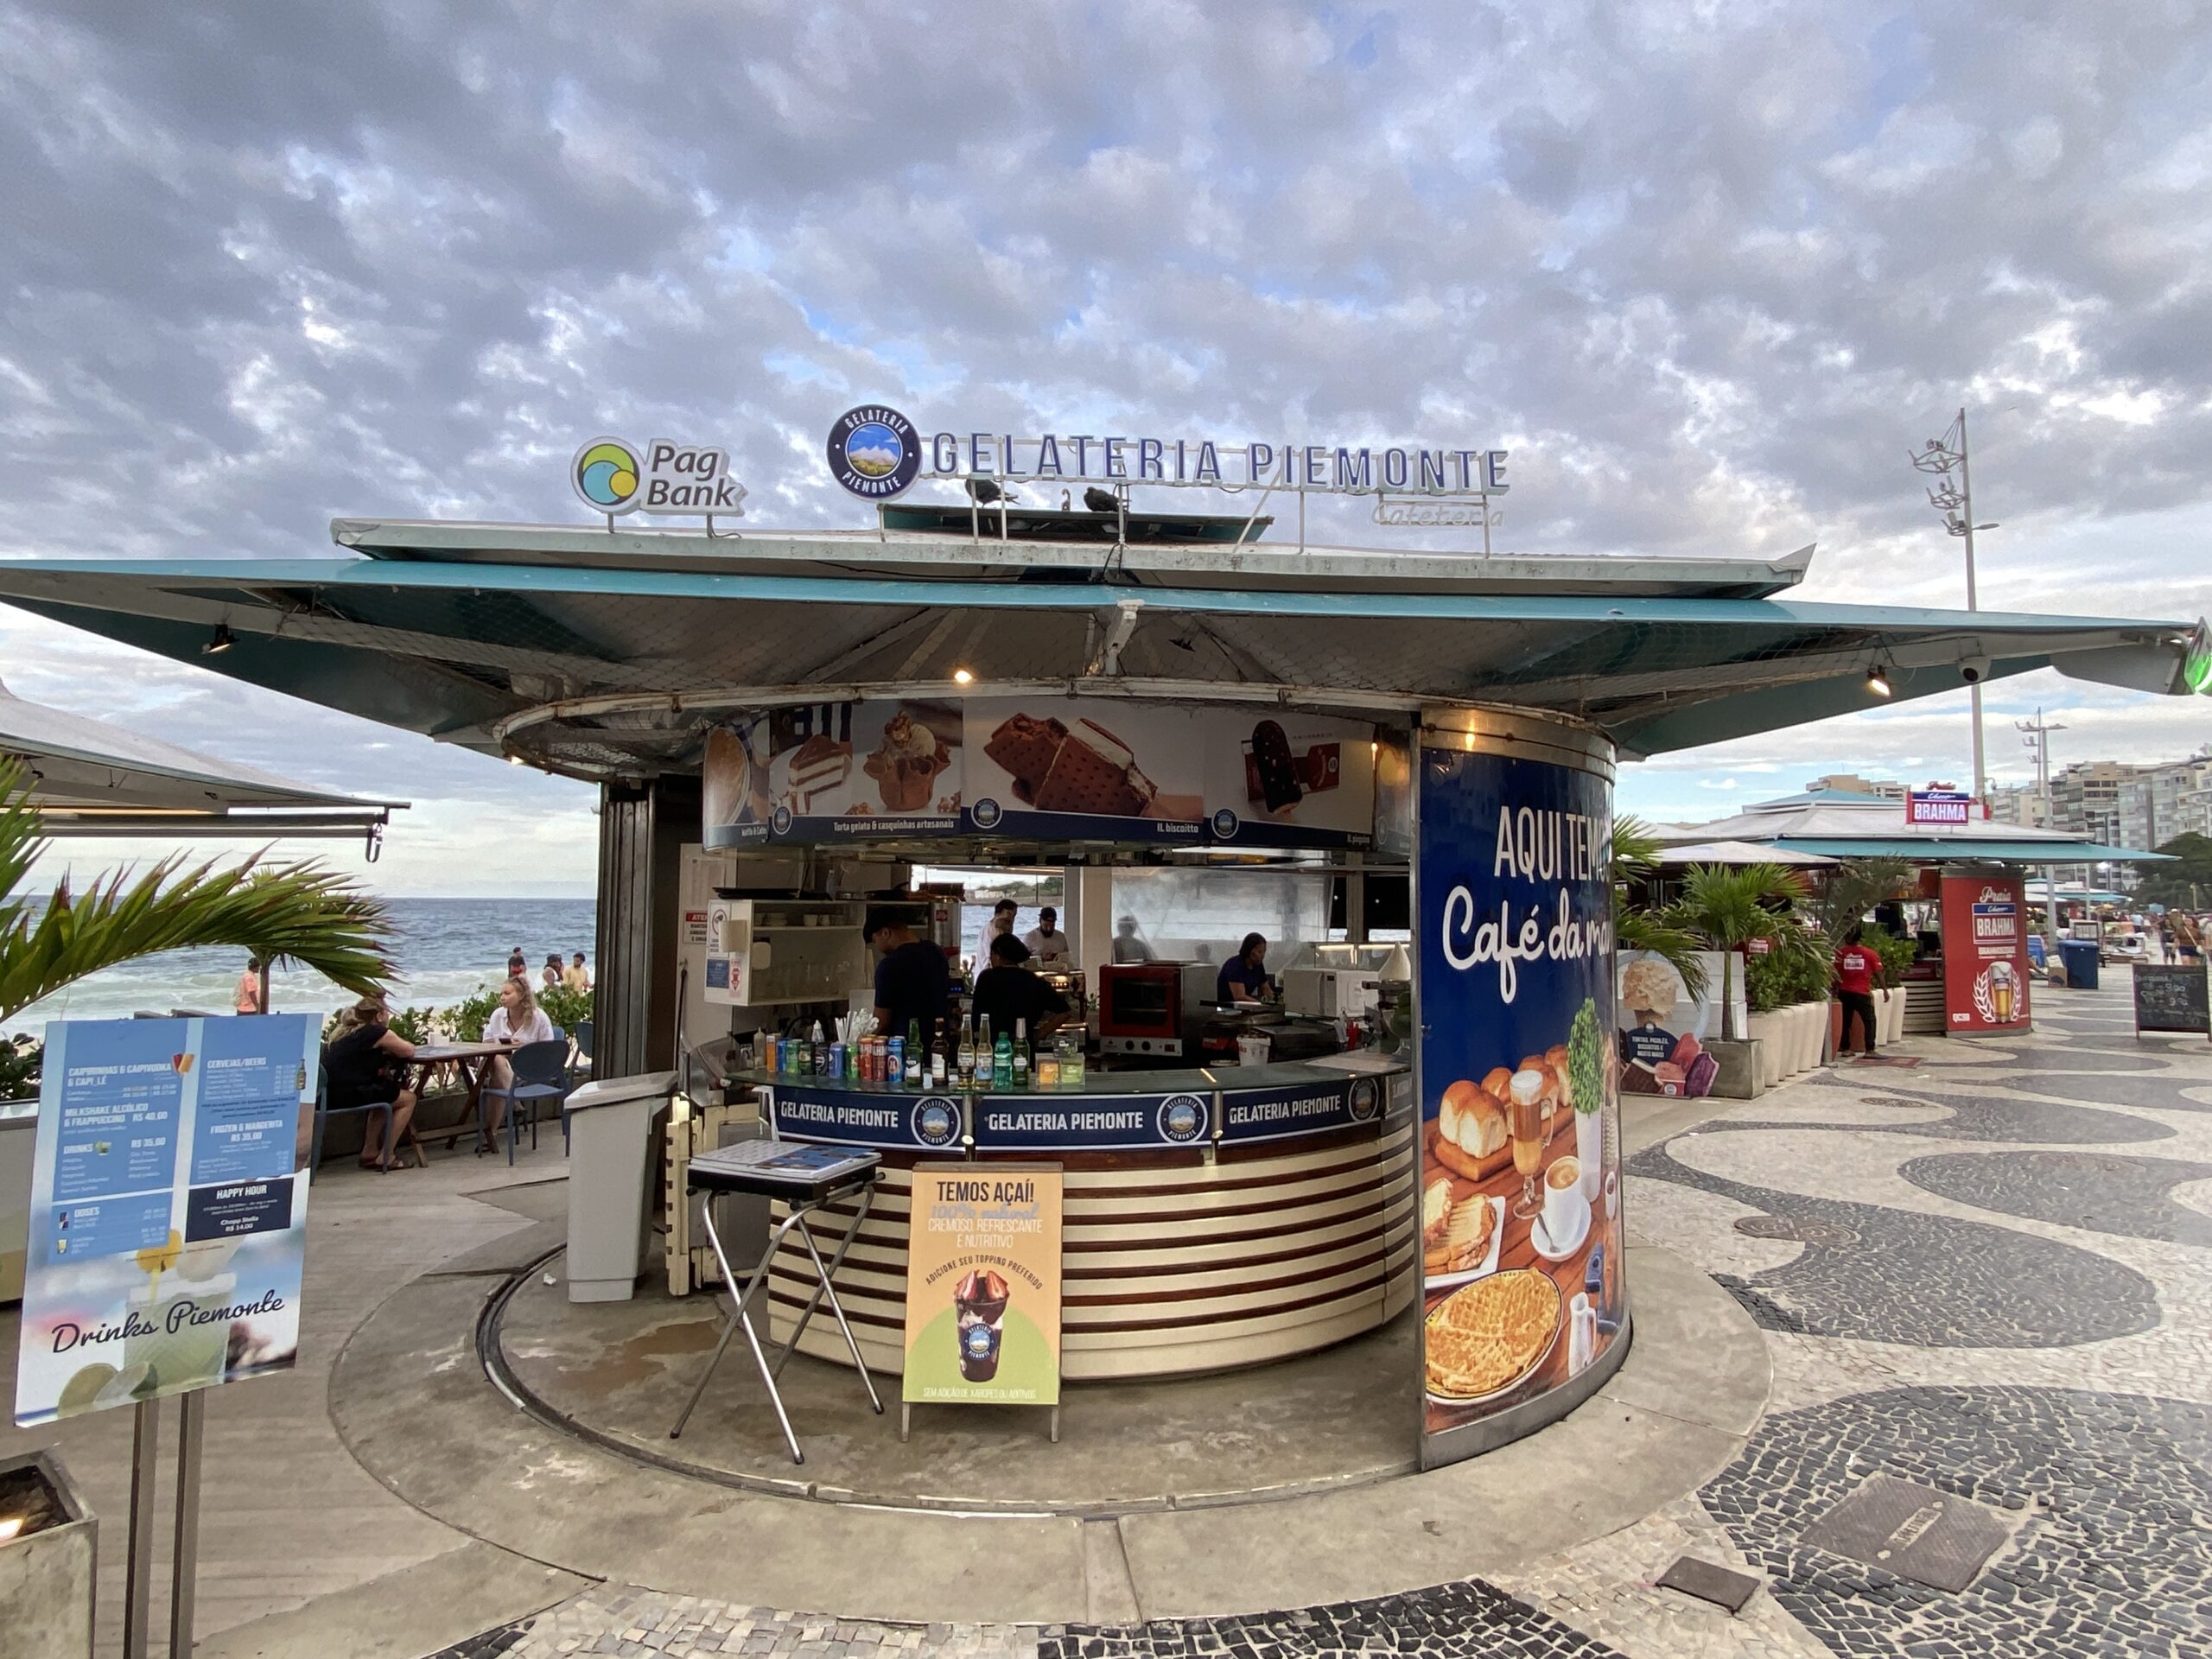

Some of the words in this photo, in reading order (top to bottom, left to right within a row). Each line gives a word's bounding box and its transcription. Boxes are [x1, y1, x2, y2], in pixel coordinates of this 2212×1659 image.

[844, 409, 909, 435] GELATERIA
[651, 445, 719, 482] Pag
[932, 430, 1224, 482] GELATERIA
[1249, 442, 1508, 490] PIEMONTE
[646, 479, 738, 507] Bank
[842, 471, 901, 493] PIEMONTE
[1914, 803, 1966, 821] BRAHMA
[834, 822, 849, 831] Torta
[850, 821, 870, 834] gelato
[878, 820, 915, 831] casquinhas
[916, 820, 954, 829] artesanais
[1493, 805, 1562, 884] AQUI
[1976, 918, 2015, 937] BRAHMA
[1441, 885, 1545, 1004] Café
[1548, 887, 1586, 961] da
[780, 1101, 836, 1123] GELATERIA
[837, 1107, 899, 1128] PIEMONTE
[988, 1112, 1068, 1131] GELATERIA
[1071, 1111, 1143, 1130] PIEMONTE
[1230, 1103, 1289, 1124] GELATERIA
[1292, 1095, 1341, 1116] PIEMONTE
[216, 1186, 244, 1199] HAPPY
[245, 1185, 268, 1197] HOUR
[937, 1181, 989, 1202] TEMOS
[994, 1179, 1034, 1206] AÇAÍ!
[976, 1218, 1043, 1234] REFRESCANTE
[957, 1234, 963, 1248] E
[964, 1234, 1014, 1249] NUTRITIVO
[925, 1260, 957, 1286] ADICIONE
[958, 1255, 973, 1267] SEU
[975, 1254, 1006, 1267] TOPPING
[1007, 1261, 1043, 1291] PREFERIDO
[51, 1312, 159, 1354] Drinks
[166, 1289, 285, 1335] Piemonte
